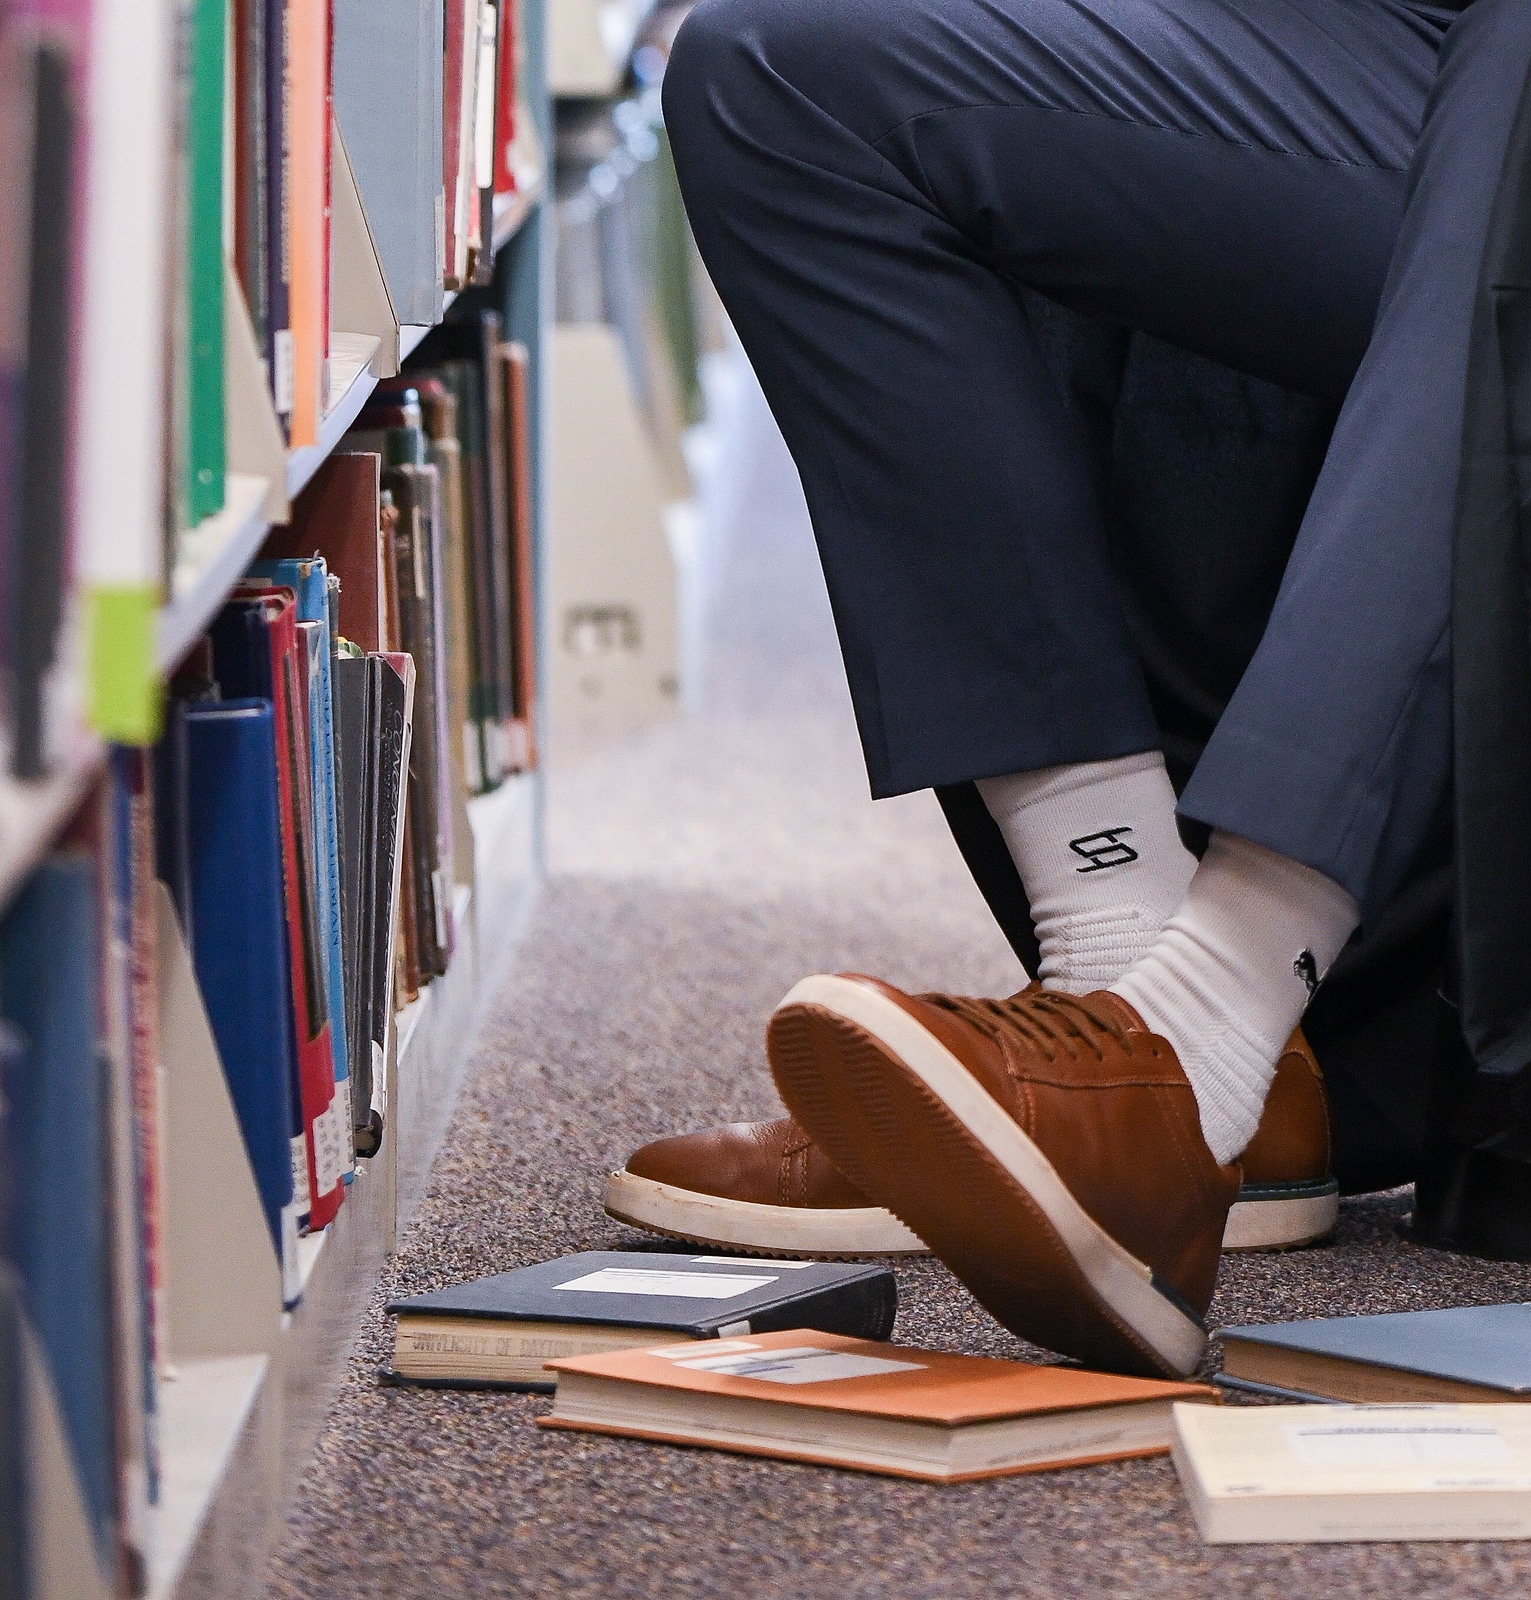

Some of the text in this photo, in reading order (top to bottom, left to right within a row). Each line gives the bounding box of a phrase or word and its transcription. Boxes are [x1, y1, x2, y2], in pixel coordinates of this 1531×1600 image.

[388, 709, 403, 872] CONGENITAL
[412, 1331, 488, 1355] UNIVERSITY
[495, 1336, 511, 1356] OF
[520, 1337, 574, 1359] DAYTON
